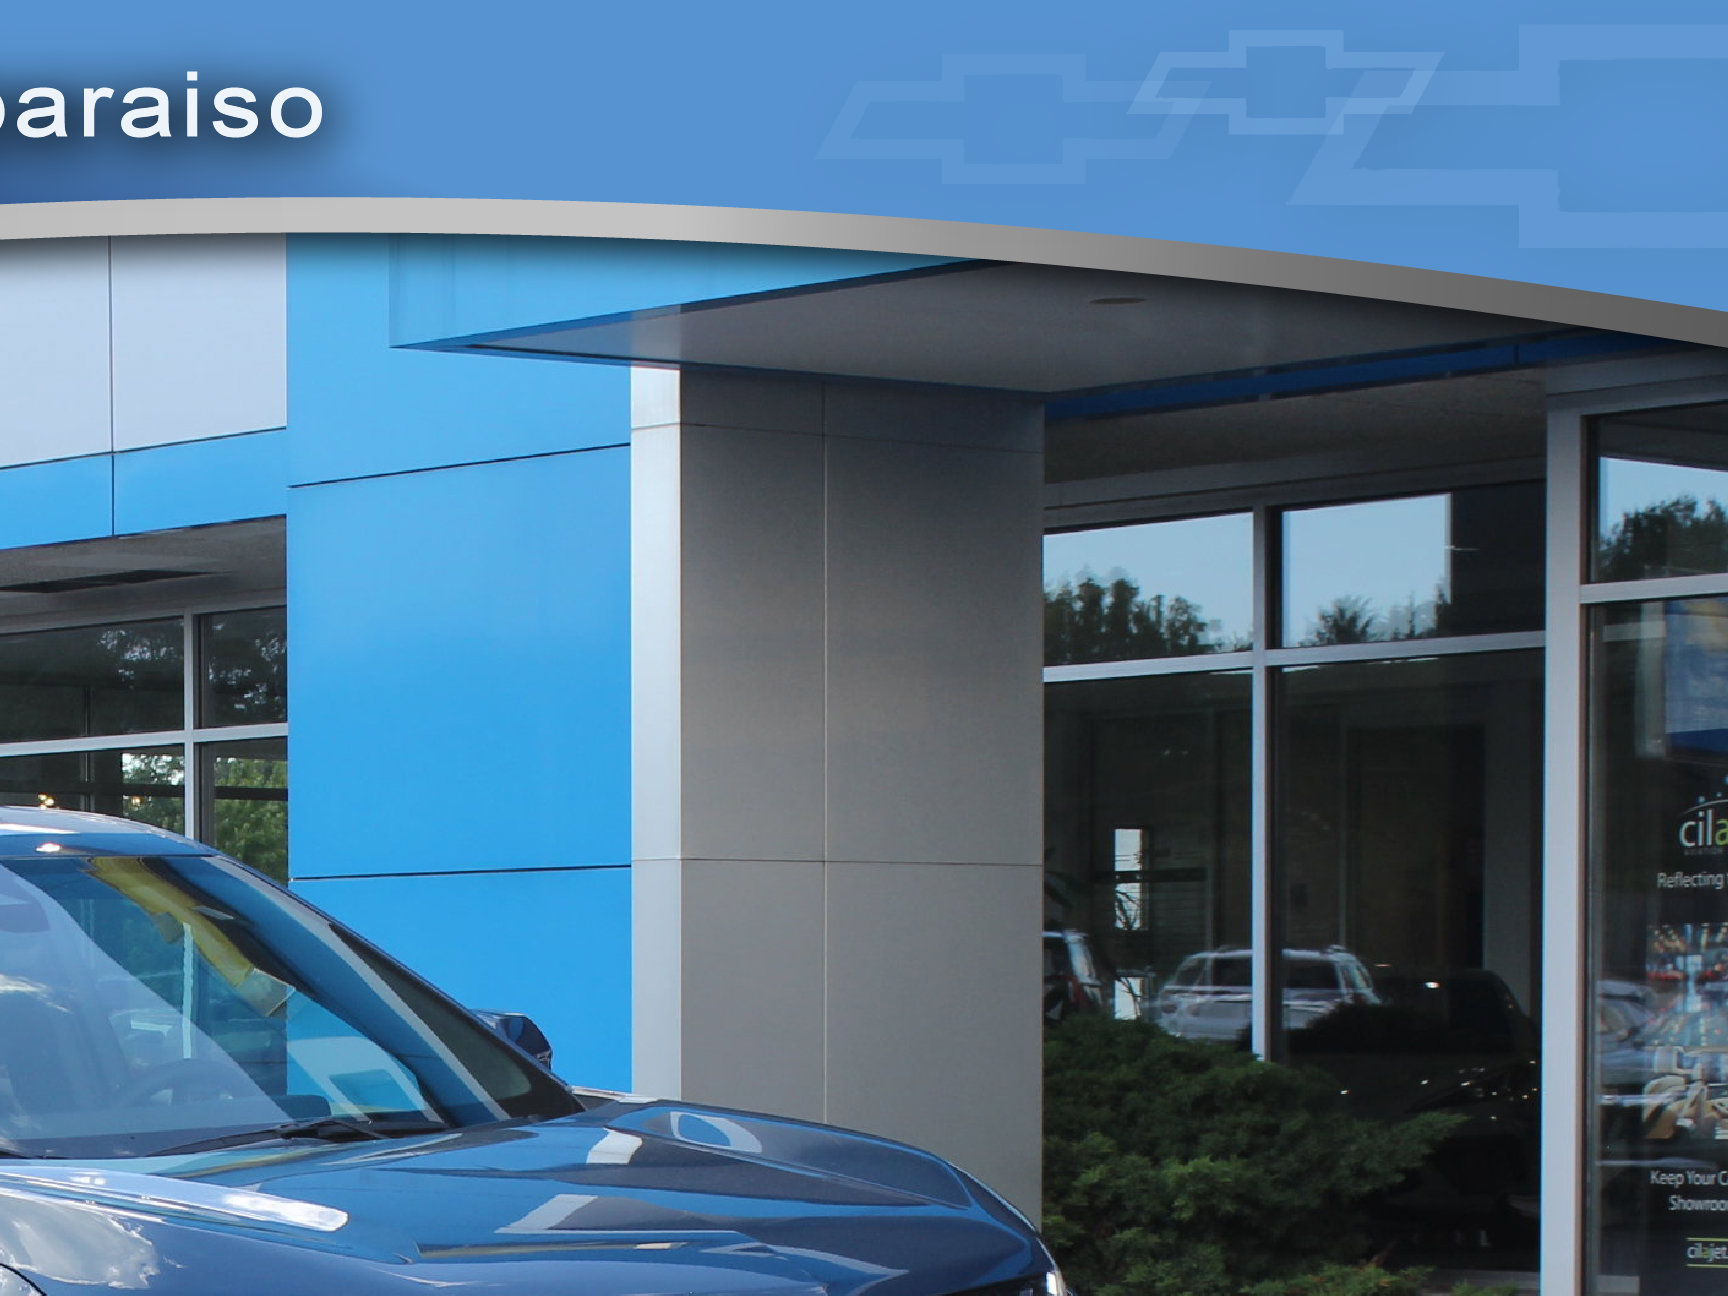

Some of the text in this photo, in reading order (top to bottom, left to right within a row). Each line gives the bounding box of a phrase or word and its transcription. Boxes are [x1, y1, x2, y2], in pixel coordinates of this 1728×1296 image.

[1656, 871, 1725, 890] Reflecting
[1650, 1170, 1684, 1188] Keep
[1686, 1170, 1716, 1185] Your
[1668, 1195, 1728, 1210] Showroo
